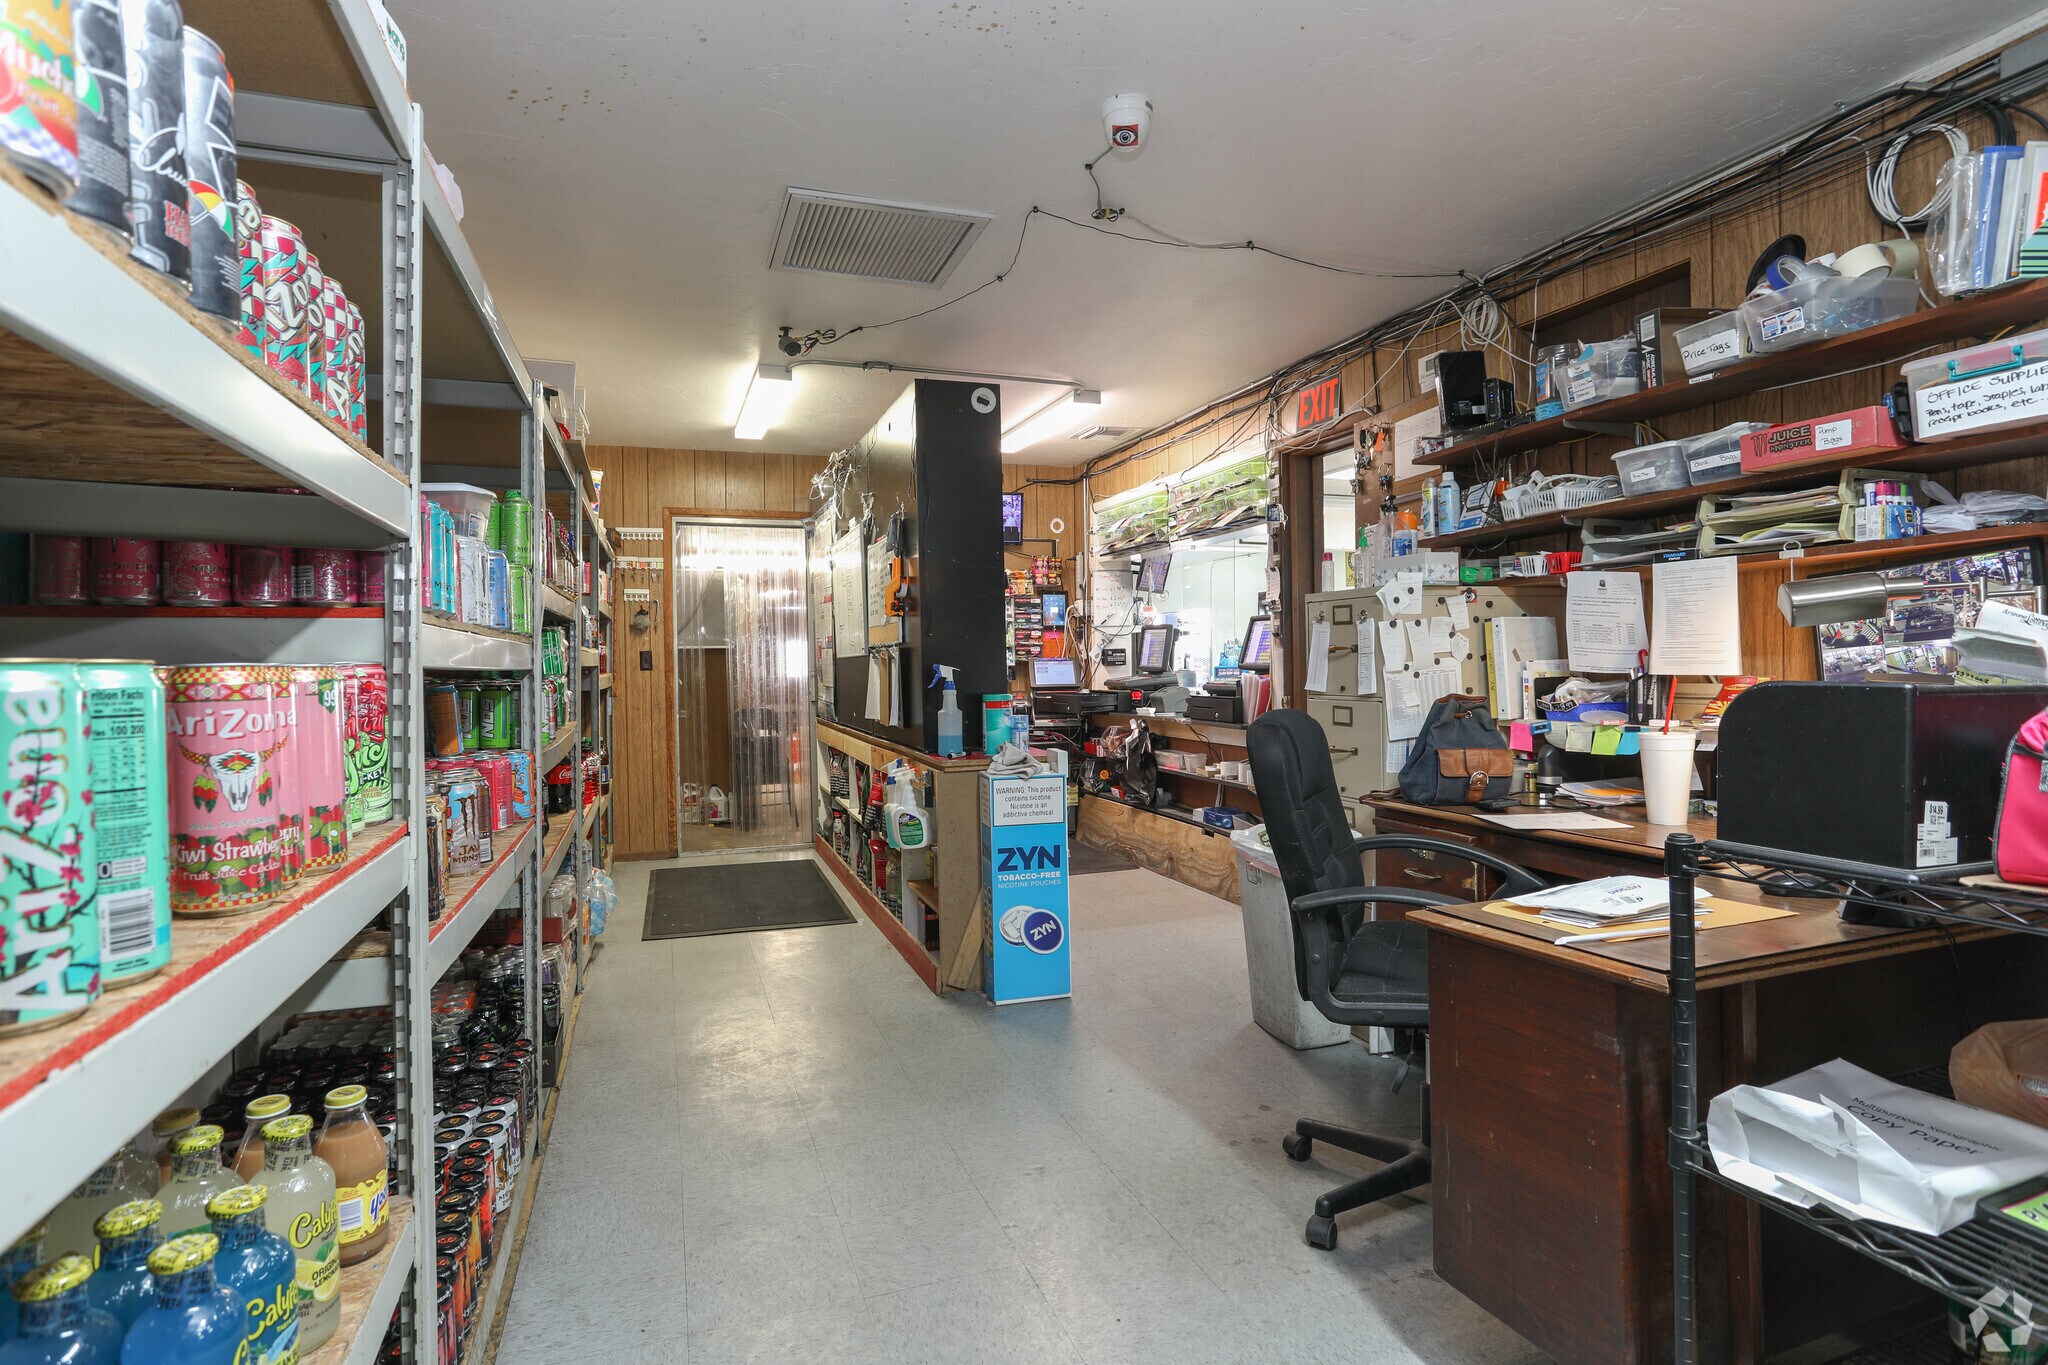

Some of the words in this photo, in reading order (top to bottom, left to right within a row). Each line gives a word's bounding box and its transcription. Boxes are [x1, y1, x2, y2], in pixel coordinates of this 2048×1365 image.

[1682, 348, 1706, 360] Price
[1706, 341, 1731, 354] Tags
[1926, 381, 1982, 404] OFFICE
[1989, 365, 2048, 386] SUPPLIE
[1298, 377, 1340, 429] EXIT
[1928, 413, 1965, 427] receipt
[1768, 424, 1812, 444] JUICE
[1817, 426, 1838, 435] Pump
[1769, 438, 1812, 453] MONSTER
[1662, 551, 1687, 559] STANDARD
[2002, 608, 2028, 620] Arizona
[90, 691, 118, 700] rition
[120, 689, 144, 700] Facts
[167, 707, 276, 740] AriZon
[480, 698, 495, 739] NOS
[110, 724, 128, 737] 100
[130, 723, 145, 735] 200
[995, 787, 1026, 795] WARNING:
[1040, 785, 1062, 794] product
[1002, 810, 1029, 818] addictive
[1028, 809, 1056, 817] chemical.
[1929, 804, 1944, 815] $14.99
[0, 683, 91, 1011] AriZona
[170, 844, 206, 863] Kiwi
[212, 836, 280, 861] Strawber
[452, 853, 480, 864] MONS
[997, 844, 1061, 872] ZYN
[182, 872, 210, 882] Fruit
[212, 866, 247, 880] Juice
[997, 871, 1061, 881] TOBACCO-FREE
[997, 881, 1029, 889] NICOTINE
[1029, 919, 1057, 941] ZYN
[1847, 1104, 1904, 1130] Copy
[1909, 1129, 1984, 1155] Paper
[1852, 1097, 1925, 1127] Multipurpose
[1927, 1125, 2004, 1152] Xerographic
[288, 1199, 338, 1249] Calyp
[246, 1279, 299, 1341] Calyp
